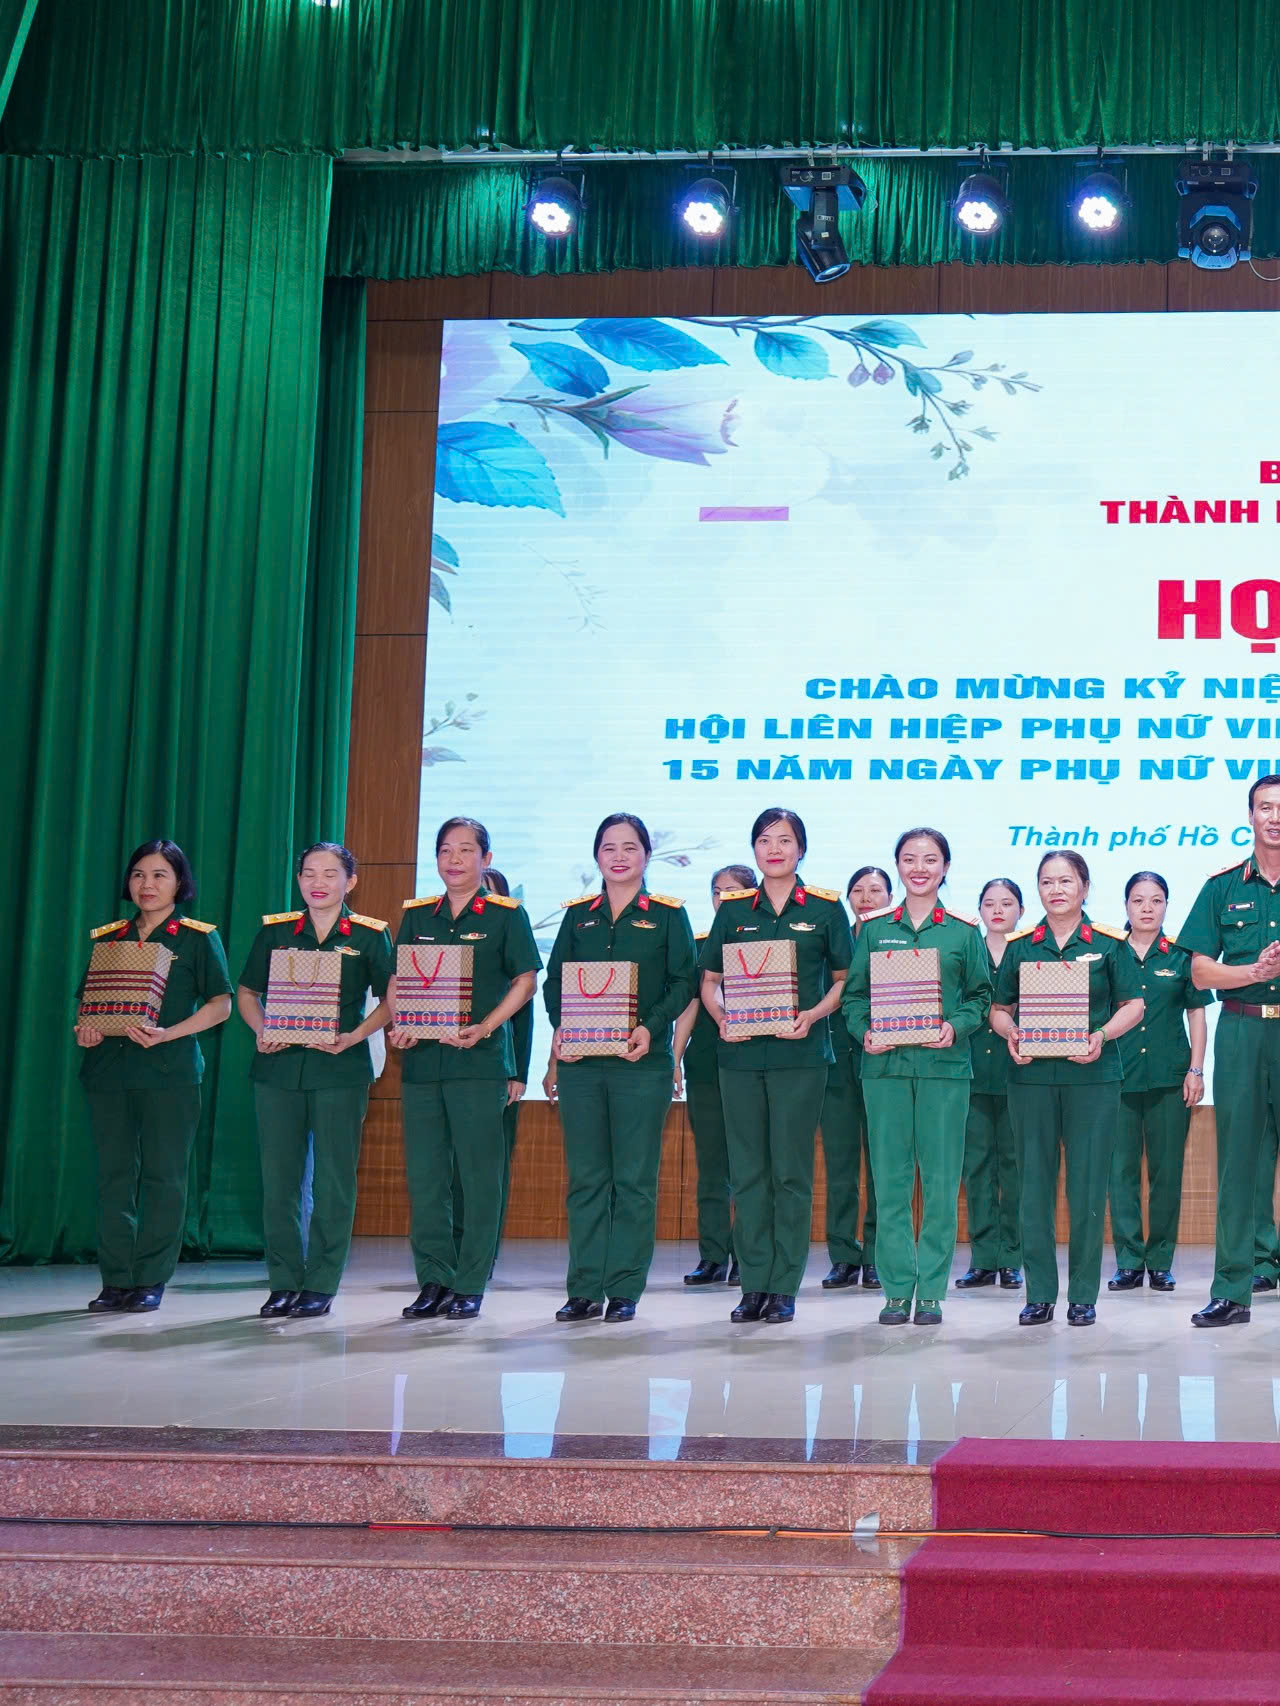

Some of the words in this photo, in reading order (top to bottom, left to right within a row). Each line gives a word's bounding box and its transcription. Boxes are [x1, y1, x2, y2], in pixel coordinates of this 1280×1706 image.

[1100, 495, 1260, 524] THÀNH
[805, 673, 939, 700] CHÀO
[955, 673, 1105, 700] MỪNG
[1123, 670, 1186, 700] KỶ
[663, 713, 747, 744] HỘI
[763, 713, 873, 740] LIÊN
[888, 712, 1003, 744] HIỆP
[1020, 717, 1121, 744] PHỤ
[1137, 713, 1214, 740] NỮ
[661, 759, 720, 781] 15
[735, 753, 853, 781] NĂM
[868, 753, 1004, 781] NGÀY
[1020, 758, 1121, 785] PHỤ
[1138, 753, 1215, 781] NỮ
[1008, 825, 1100, 848] Thành
[1108, 825, 1168, 854] phố
[1176, 824, 1220, 848] Hồ
